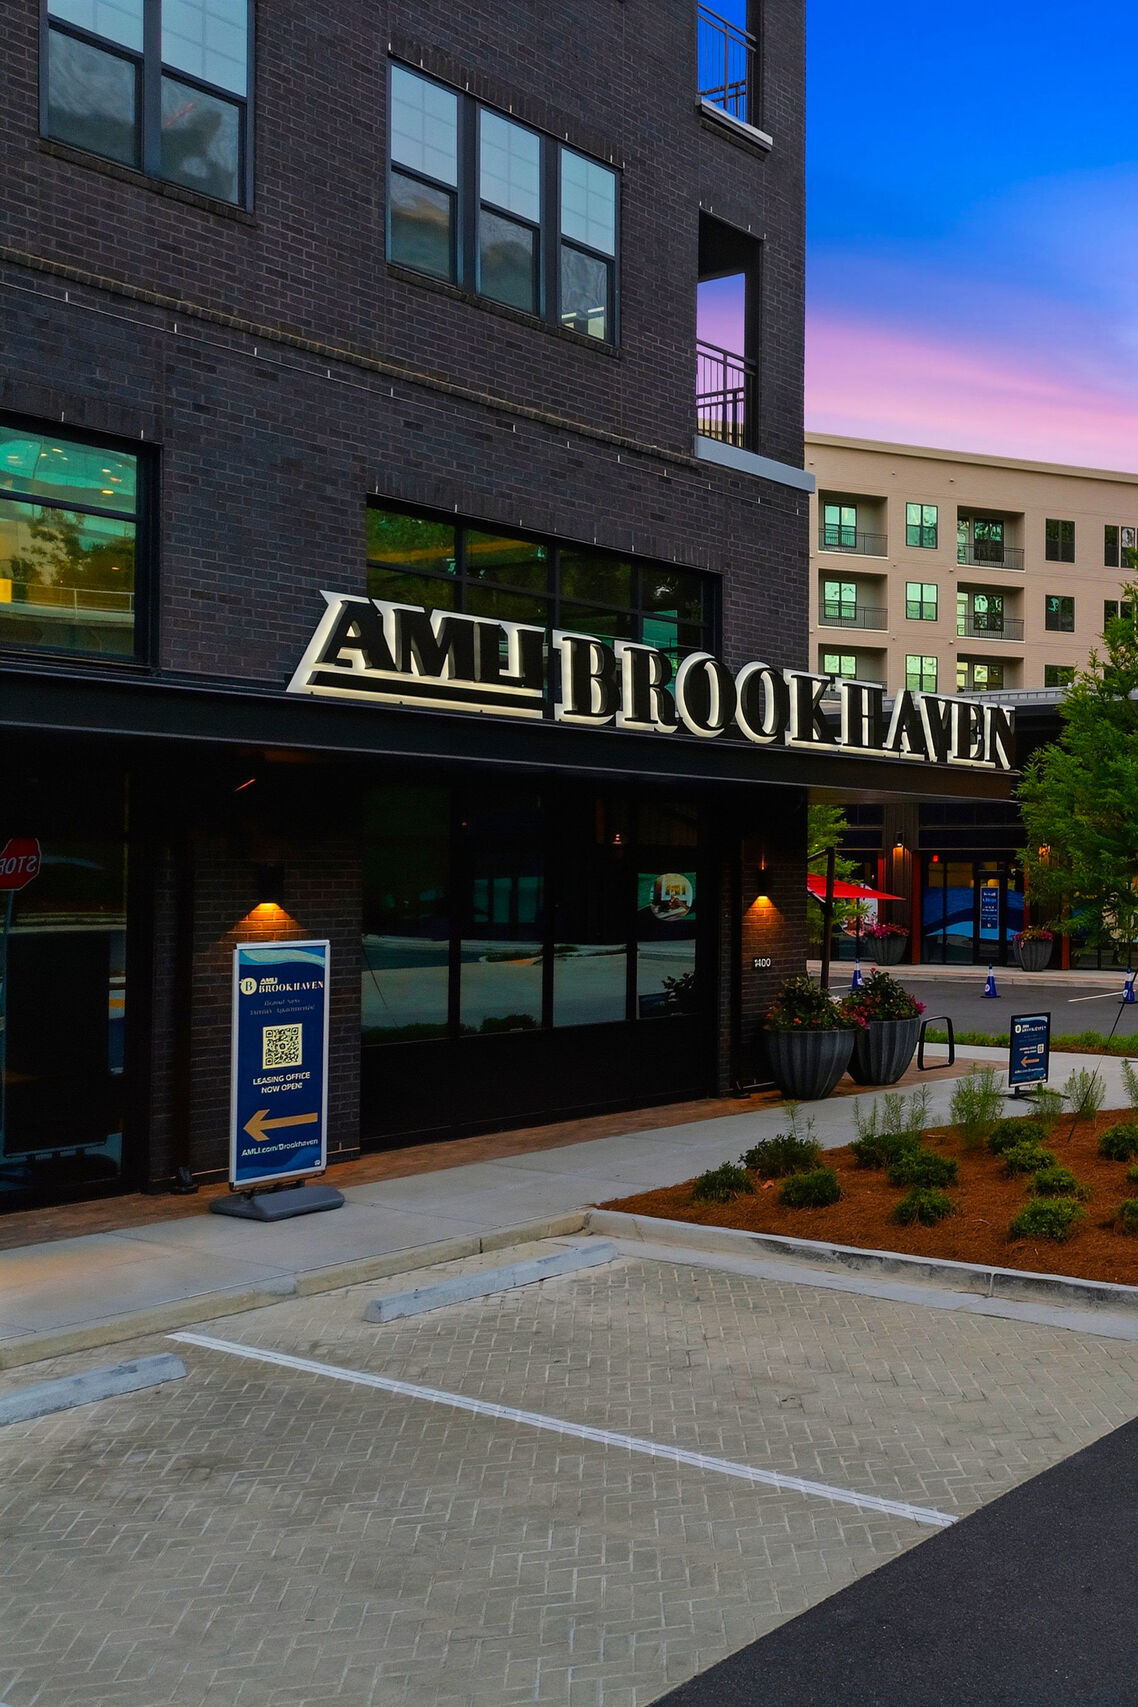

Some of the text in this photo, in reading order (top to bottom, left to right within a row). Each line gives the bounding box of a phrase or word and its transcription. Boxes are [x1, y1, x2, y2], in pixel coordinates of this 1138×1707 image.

[286, 590, 1016, 771] AMLI BROOKHAVEN
[259, 981, 324, 993] BROOKHAVEN
[253, 1071, 311, 1086] LEASING OFFICE
[261, 1085, 280, 1094] NOW
